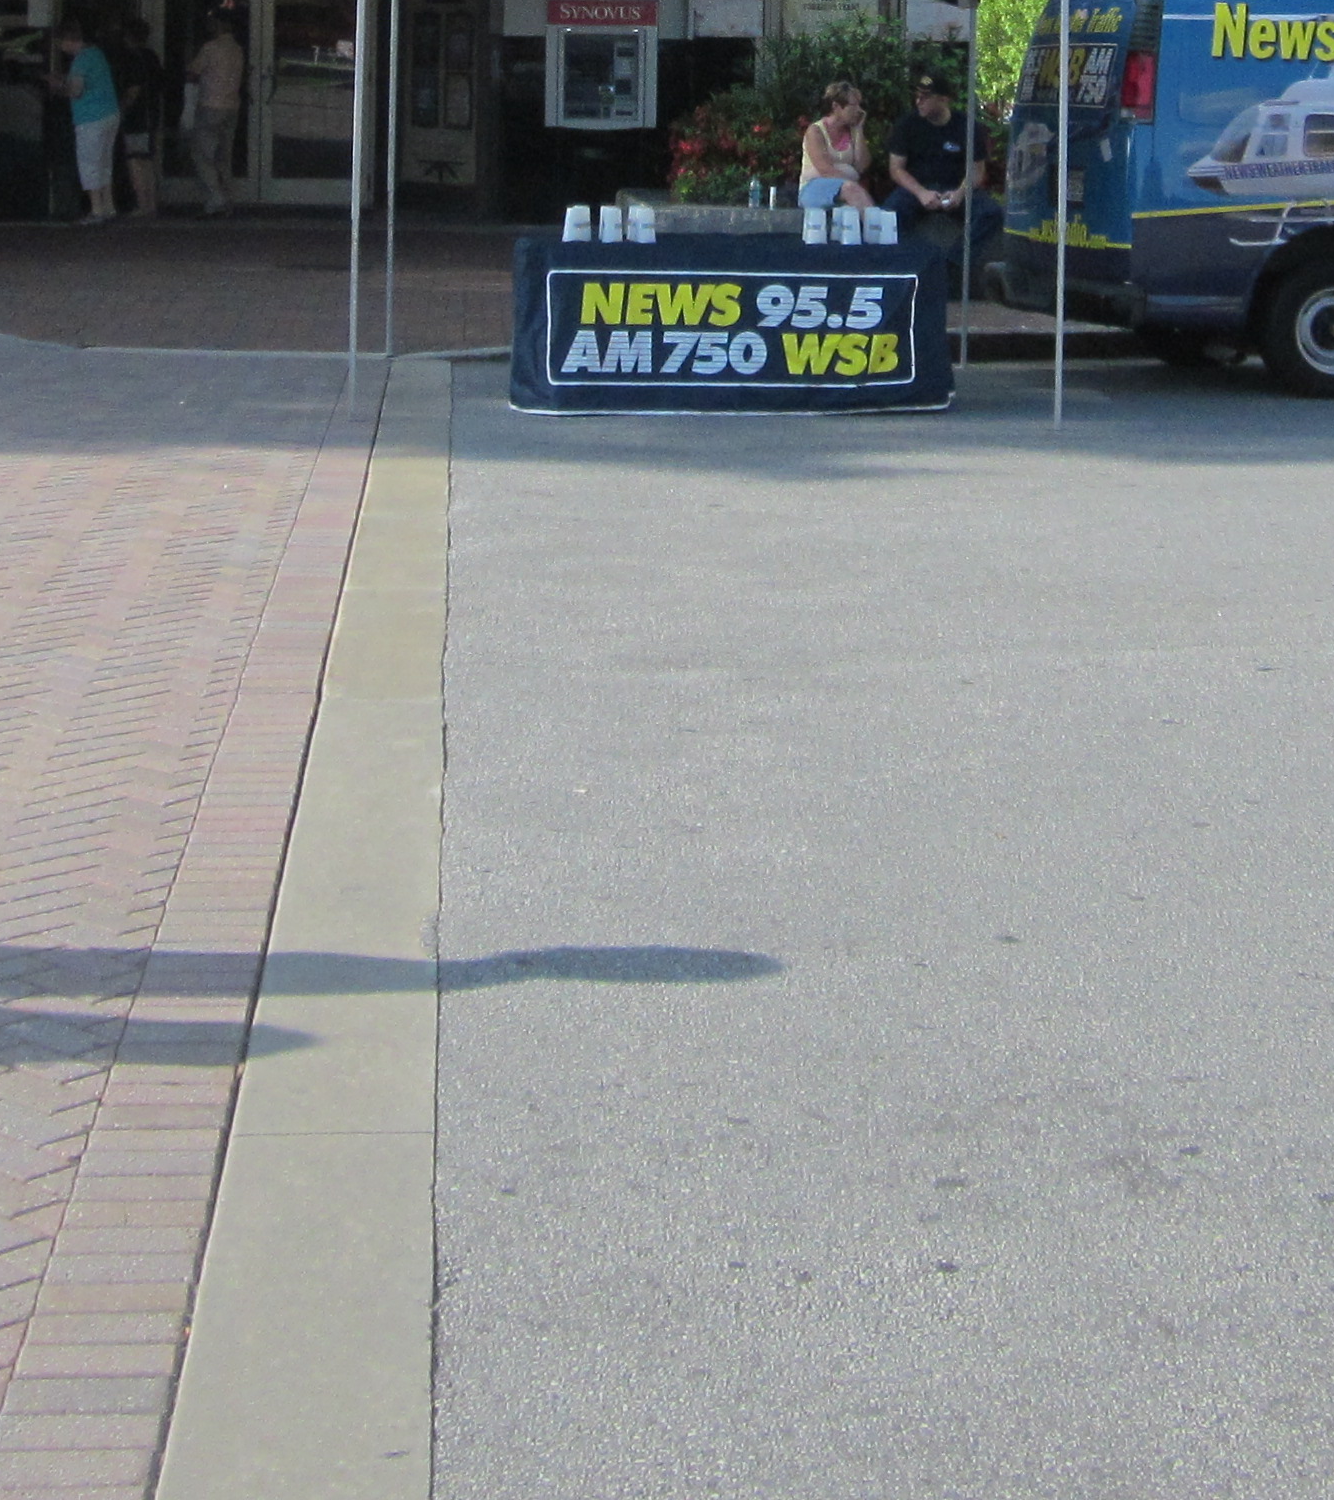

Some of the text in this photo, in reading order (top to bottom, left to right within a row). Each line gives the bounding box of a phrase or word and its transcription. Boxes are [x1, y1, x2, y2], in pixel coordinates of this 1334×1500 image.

[559, 3, 642, 21] SYNOVUS
[579, 282, 884, 330] NEWS 95.5
[560, 329, 899, 377] AM 750 WSB
